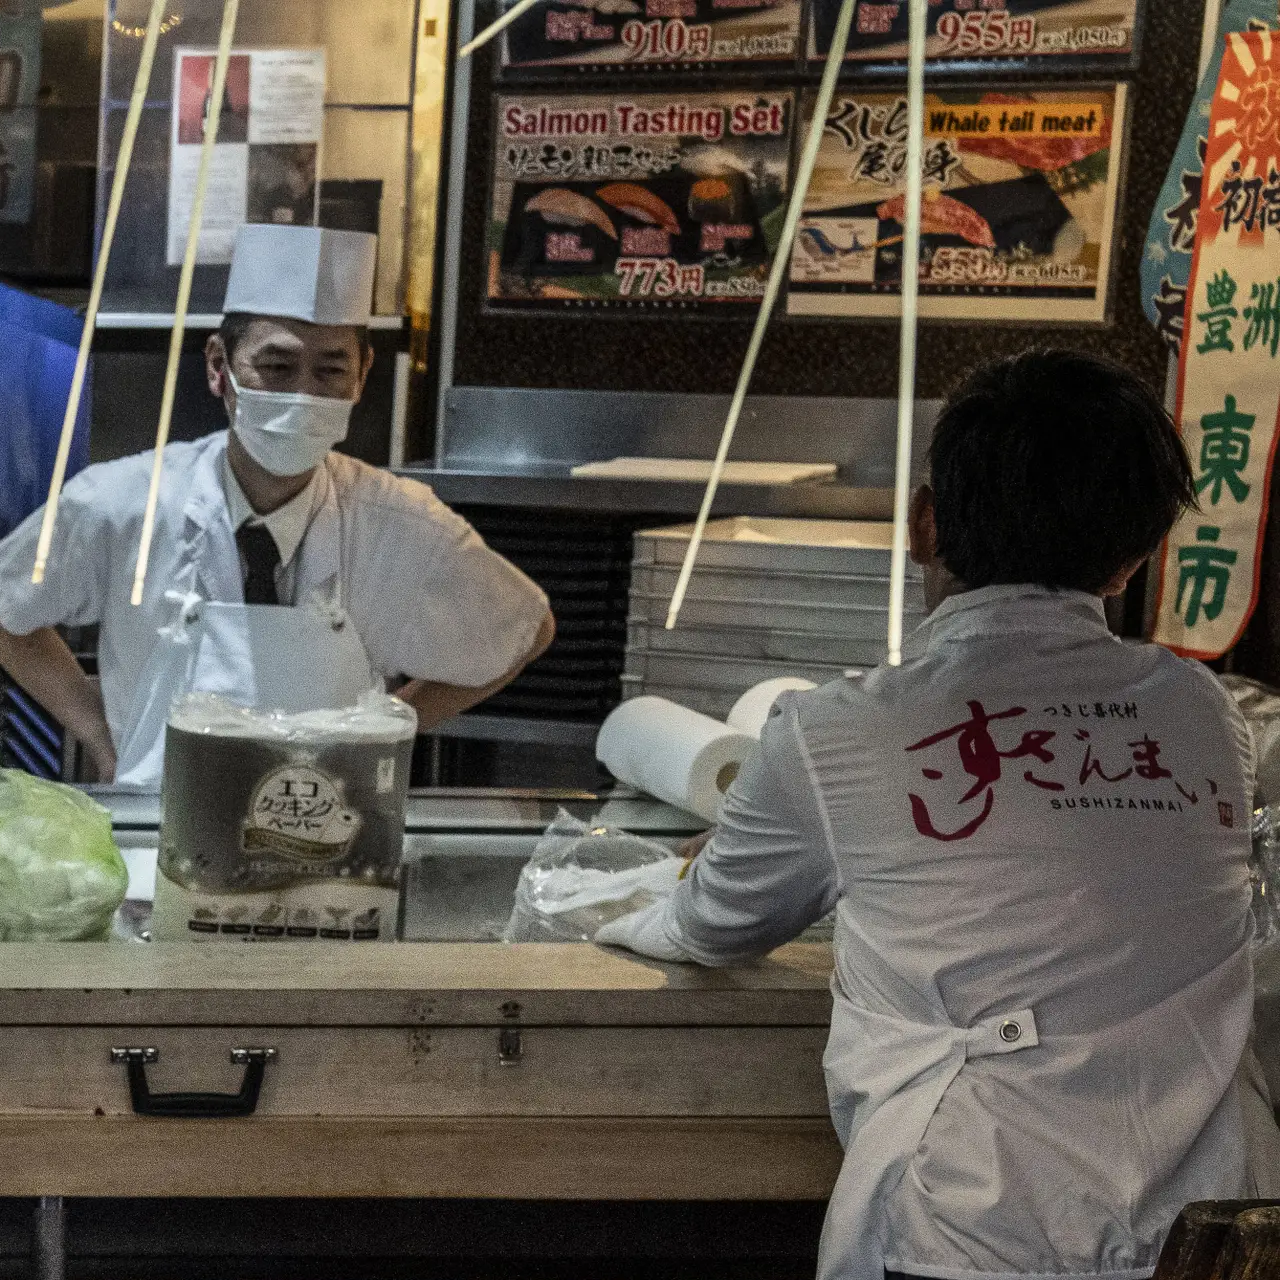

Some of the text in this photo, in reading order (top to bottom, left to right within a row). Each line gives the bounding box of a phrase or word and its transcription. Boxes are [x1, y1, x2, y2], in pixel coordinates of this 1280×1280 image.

[937, 10, 1036, 50] 955円
[504, 101, 783, 140] Salmon Tasting Set
[930, 109, 1097, 132] Whale tail meat
[616, 257, 704, 296] 773円
[277, 779, 318, 797] エコ
[255, 796, 334, 816] クッキング
[1050, 798, 1183, 812] SUSHIZANMAI
